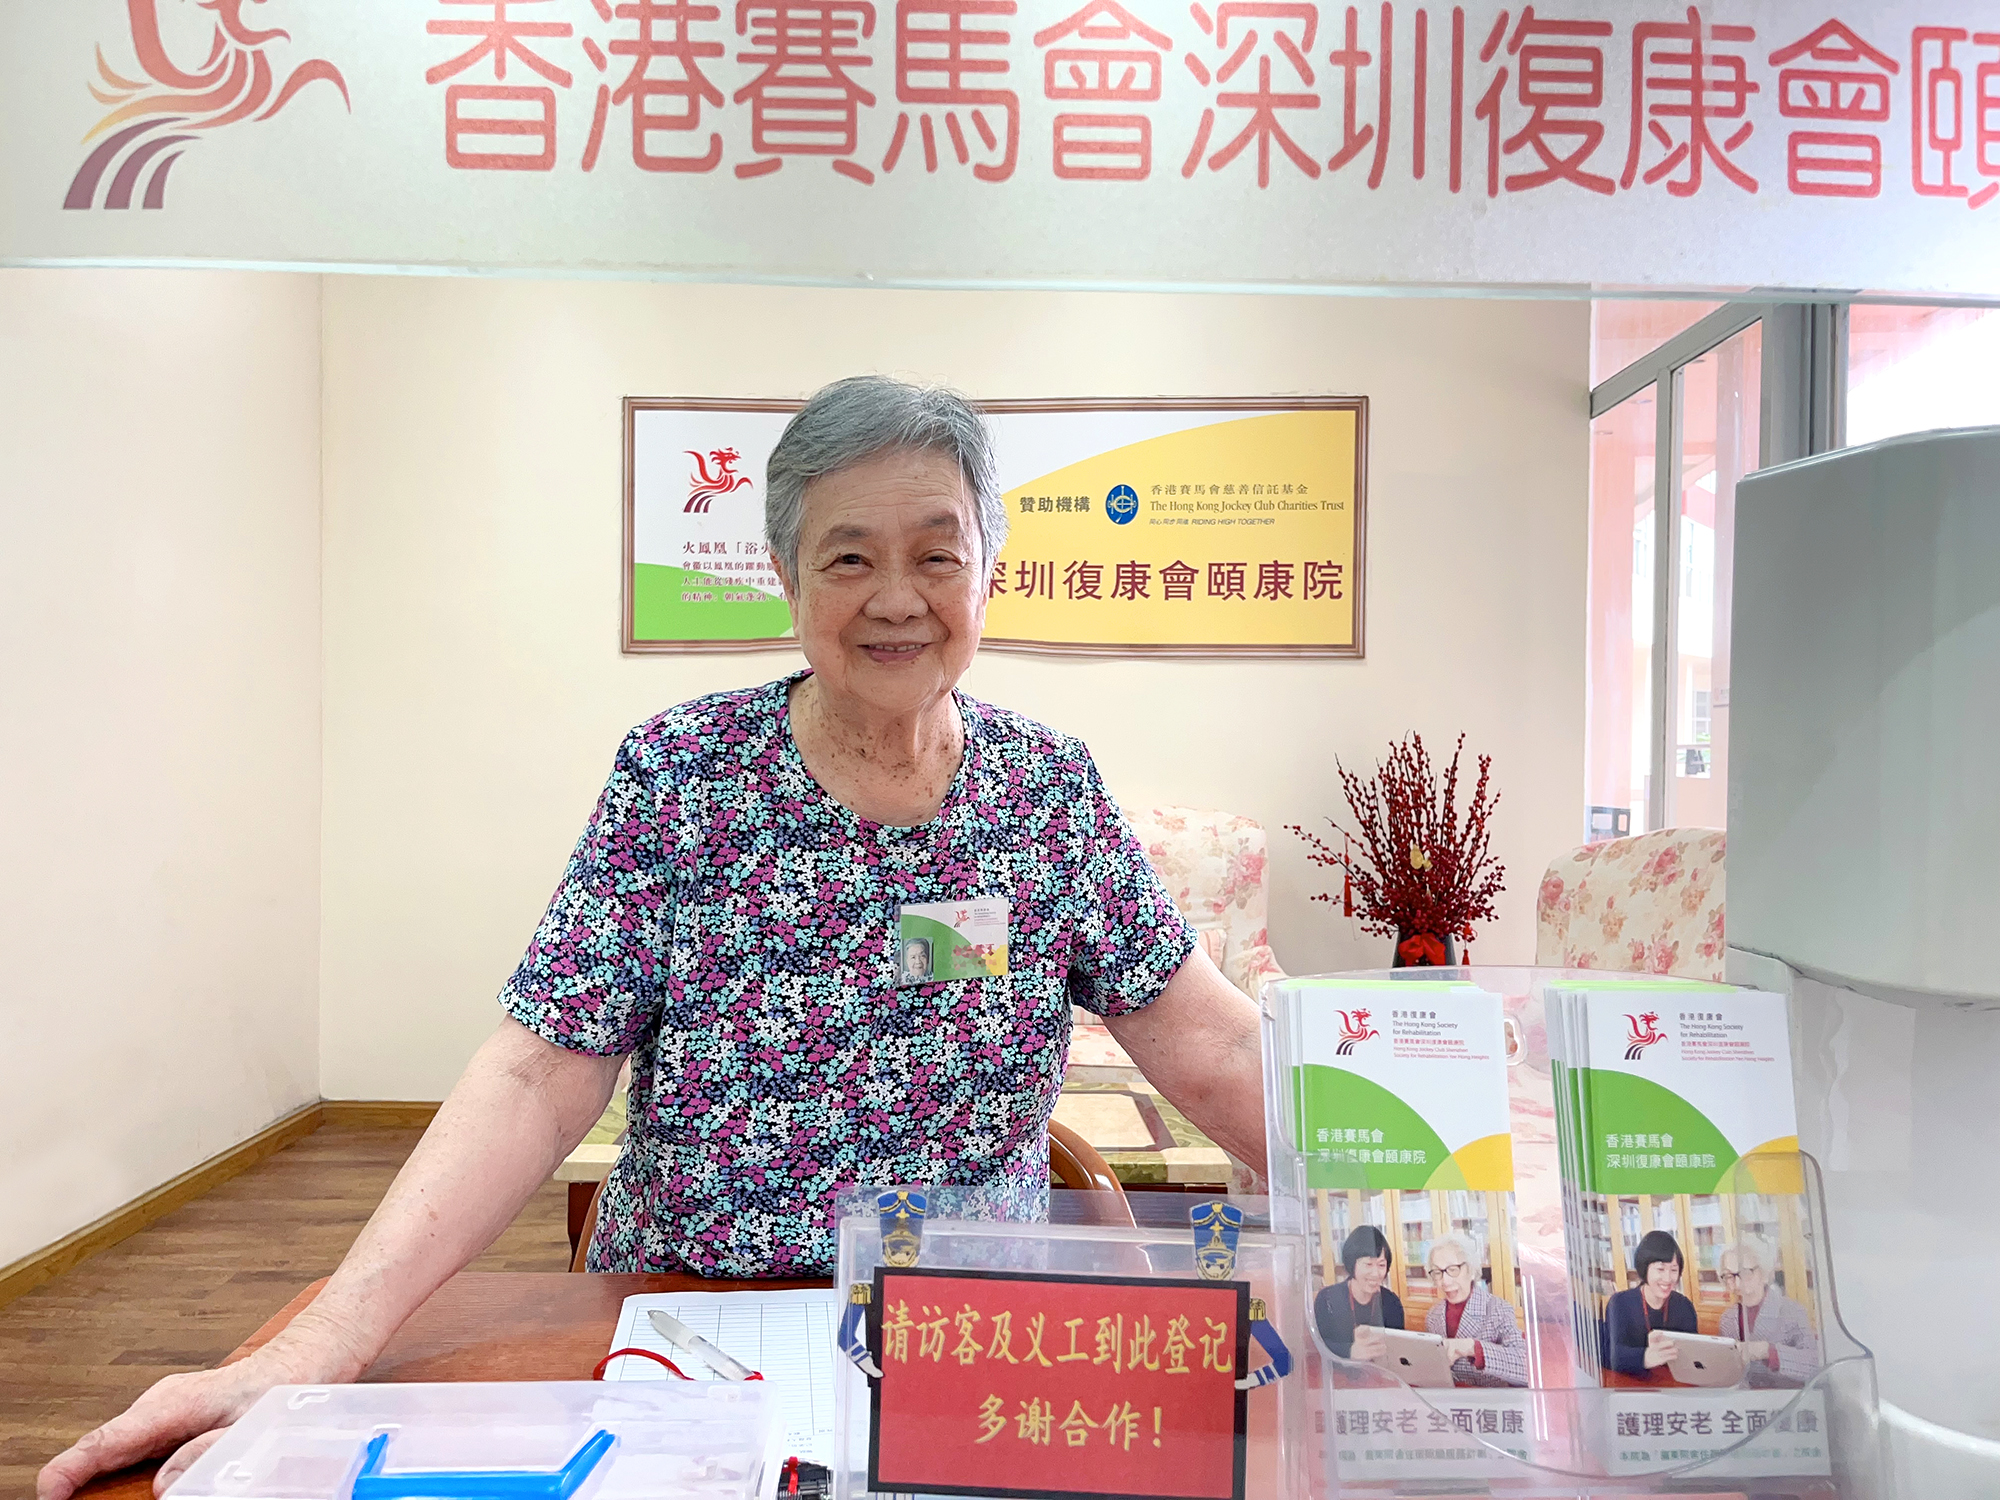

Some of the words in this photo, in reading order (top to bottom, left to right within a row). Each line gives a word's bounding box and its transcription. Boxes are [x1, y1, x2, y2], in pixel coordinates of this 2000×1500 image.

[1151, 484, 1308, 495] 香港賽馬會慈善信託基金
[1020, 496, 1091, 513] 贊助機構
[1150, 501, 1167, 511] The
[1169, 501, 1194, 513] Hong
[1196, 501, 1219, 513] Kong
[1220, 500, 1251, 513] Jockey
[1254, 500, 1275, 511] Club
[1277, 500, 1318, 511] Charities
[1320, 500, 1344, 510] Trust
[1317, 1128, 1384, 1143] 香港賽馬會
[1605, 1133, 1673, 1148] 香港賽馬會
[1606, 1153, 1716, 1169] 深圳復康會頤康院
[881, 1299, 1234, 1375] 请访客及义工到此登记
[975, 1394, 1162, 1452] 多谢合作！
[1426, 1408, 1525, 1434] 全面復康
[1616, 1411, 1713, 1436] 護理安老
